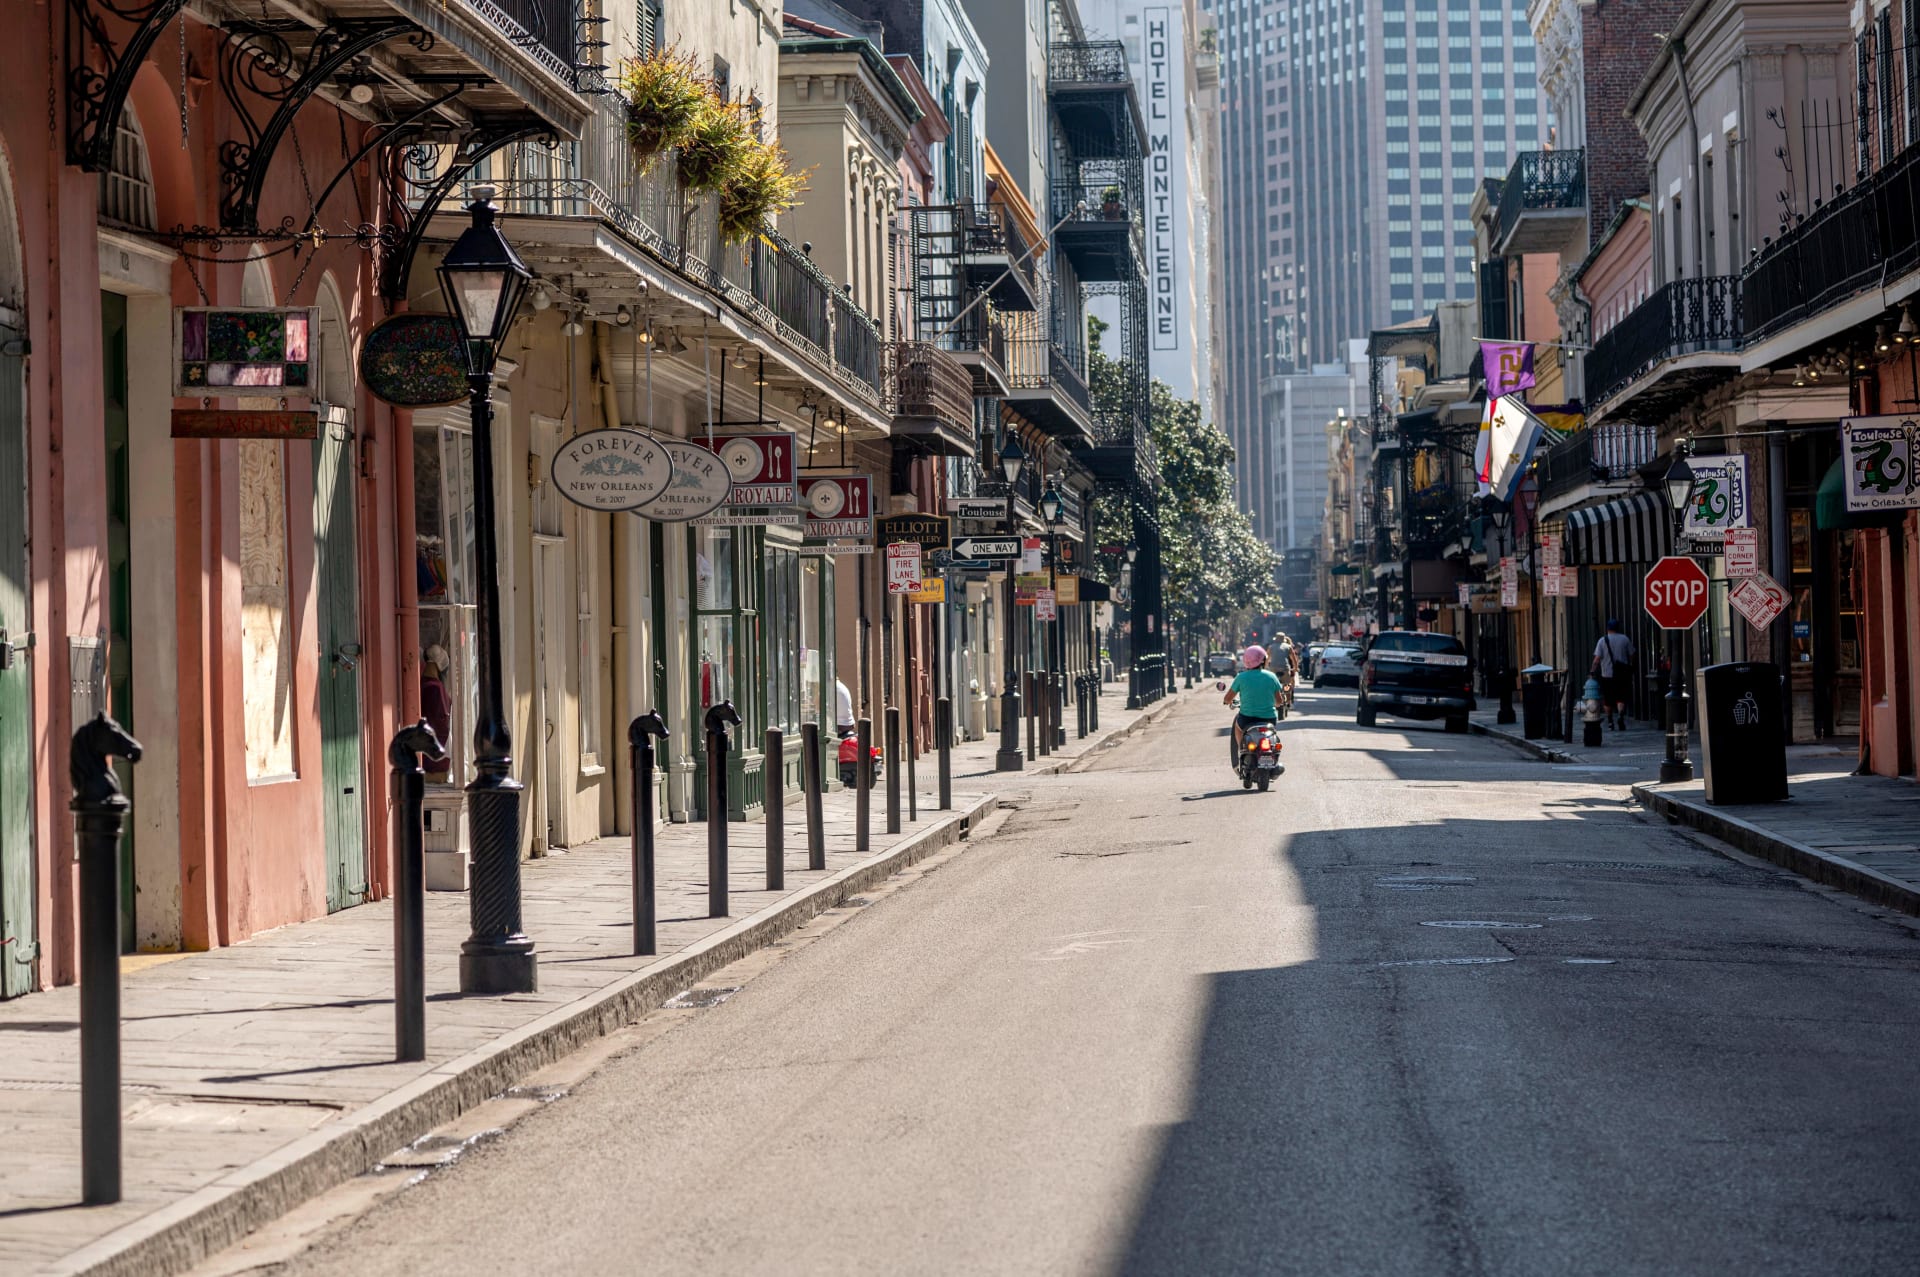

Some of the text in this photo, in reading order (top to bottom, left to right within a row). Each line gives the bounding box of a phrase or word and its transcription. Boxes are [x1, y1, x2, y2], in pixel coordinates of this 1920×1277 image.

[1150, 21, 1172, 334] HOTEL MONTELEONE
[215, 414, 290, 433] JARDIN
[1853, 430, 1902, 441] Toulouse
[570, 437, 654, 464] FOREVER
[671, 450, 713, 478] EVER
[570, 481, 653, 491] NEW ORLEANS
[660, 494, 711, 504] ORLEANS
[735, 487, 793, 504] ROYALE
[1733, 470, 1742, 518] Royale
[596, 496, 626, 504] Est. 2007
[654, 508, 684, 516] Est. 2007
[960, 507, 1005, 517] Toulouse
[691, 517, 726, 525] ENTERTAIN
[745, 516, 774, 524] ORLEANS
[820, 521, 869, 536] ROYALE
[885, 522, 941, 534] ELLIOTT
[904, 535, 942, 543] GALLERY
[1725, 533, 1734, 542] NO
[889, 546, 899, 556] NO
[973, 543, 1014, 553] ONE WAY
[1689, 543, 1724, 552] Toulo
[896, 560, 912, 568] FIRE
[895, 570, 914, 579] LANE
[1649, 579, 1704, 607] STOP
[1744, 592, 1760, 609] ZONE
[1746, 595, 1768, 616] FREIGHT
